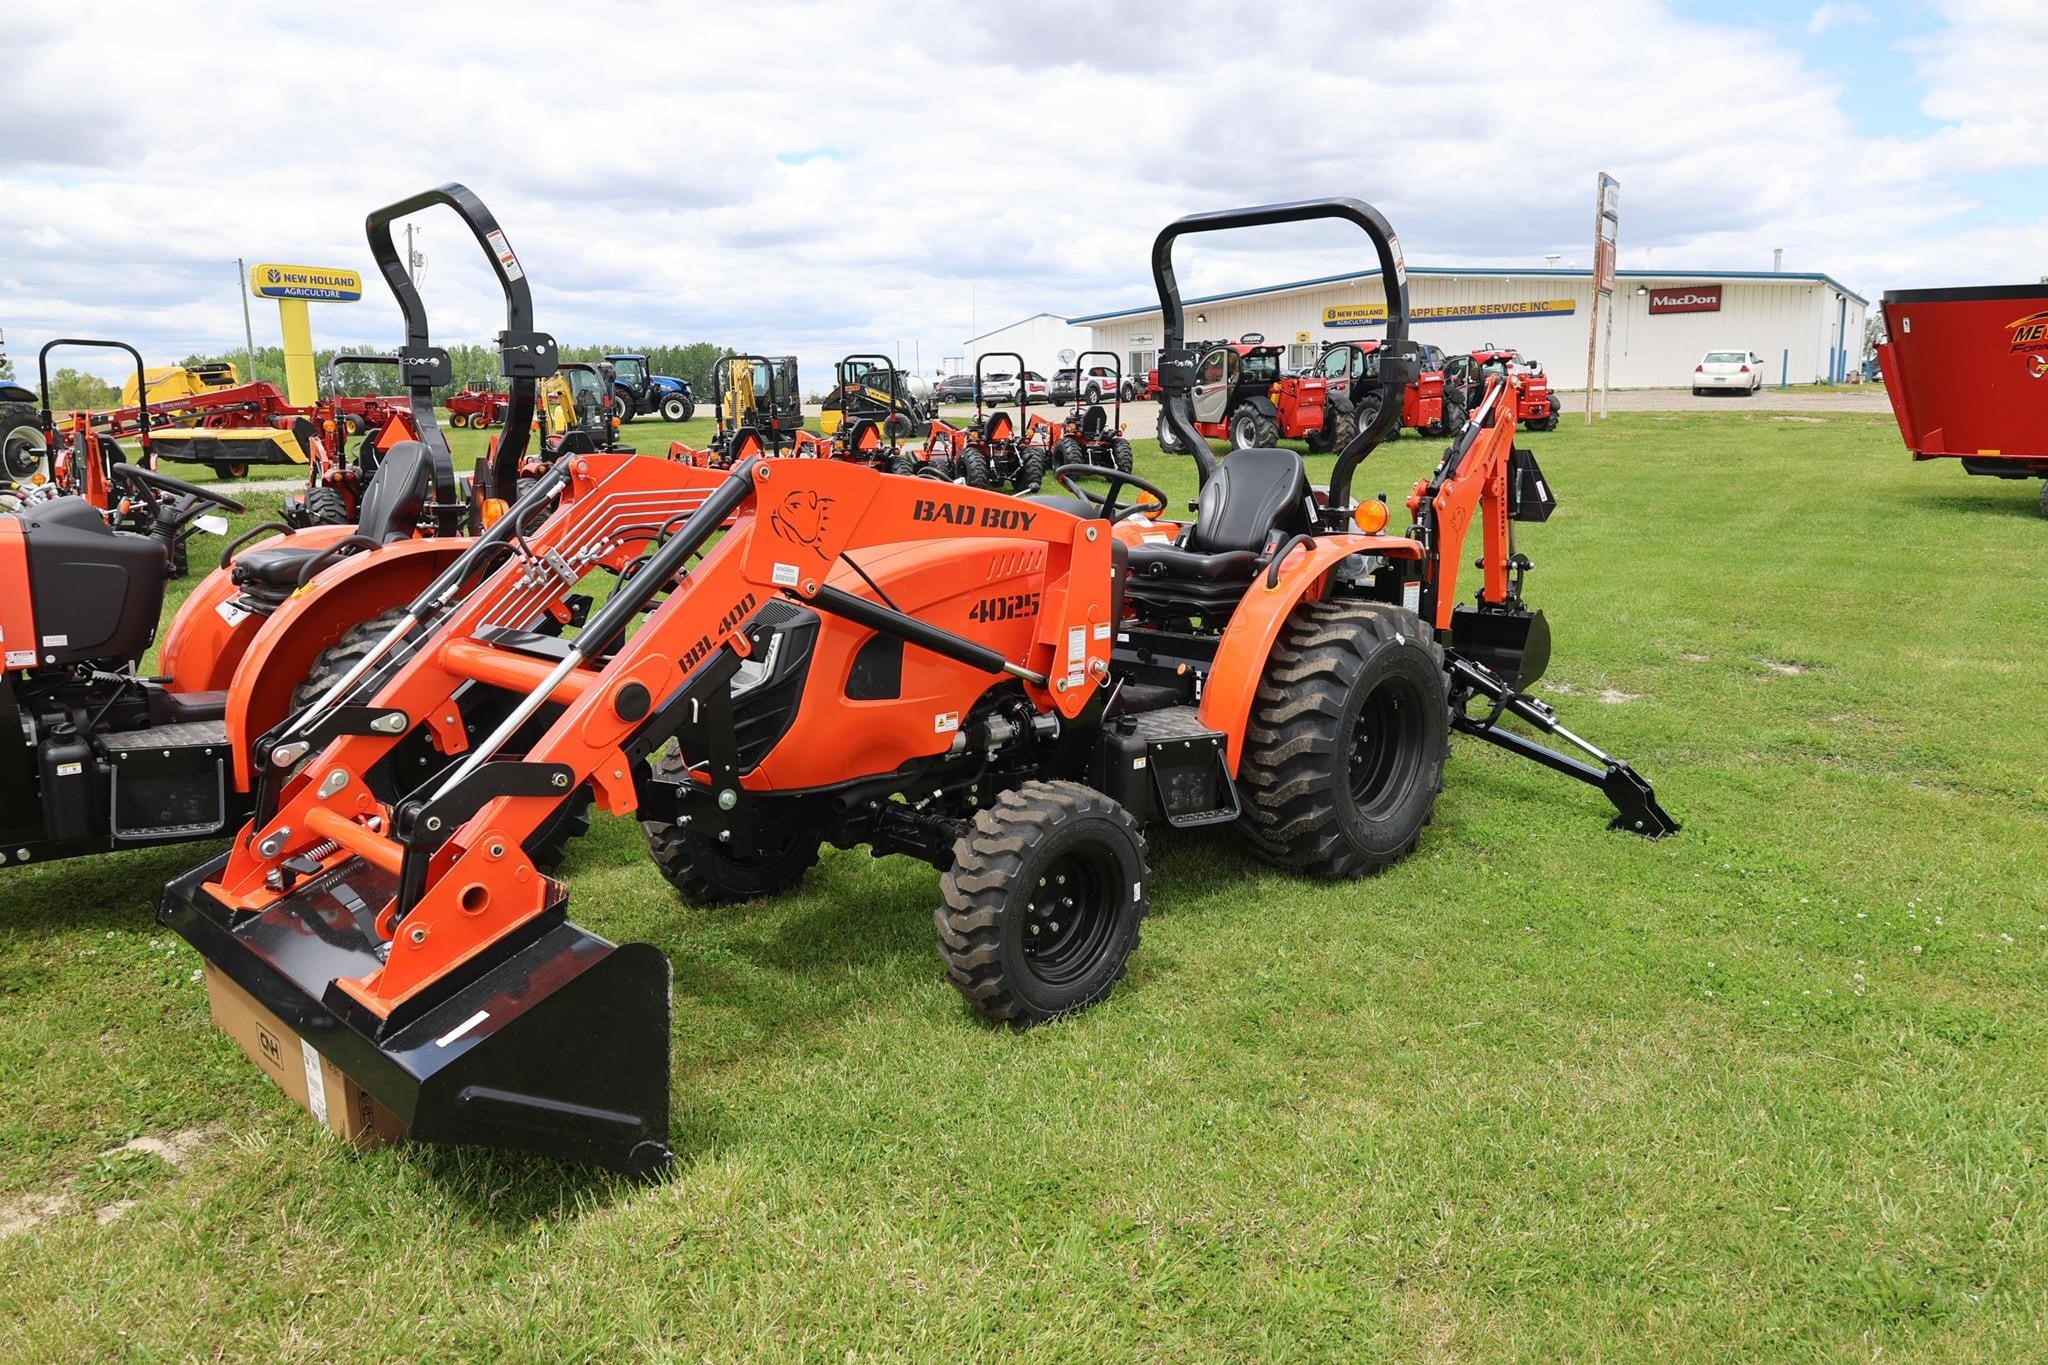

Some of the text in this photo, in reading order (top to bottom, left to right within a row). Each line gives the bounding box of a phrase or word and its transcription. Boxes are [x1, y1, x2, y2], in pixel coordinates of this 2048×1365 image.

[284, 274, 355, 287] NEW HOLLAND
[284, 287, 341, 298] AGRICULTURE
[1653, 294, 1717, 306] MacDon
[1336, 308, 1384, 318] NEW HOLLAND
[1410, 301, 1553, 318] APPLE FARM SERVICE INC.
[913, 499, 1038, 532] BAD BOY
[718, 592, 756, 636] 400
[968, 592, 1041, 624] 4025
